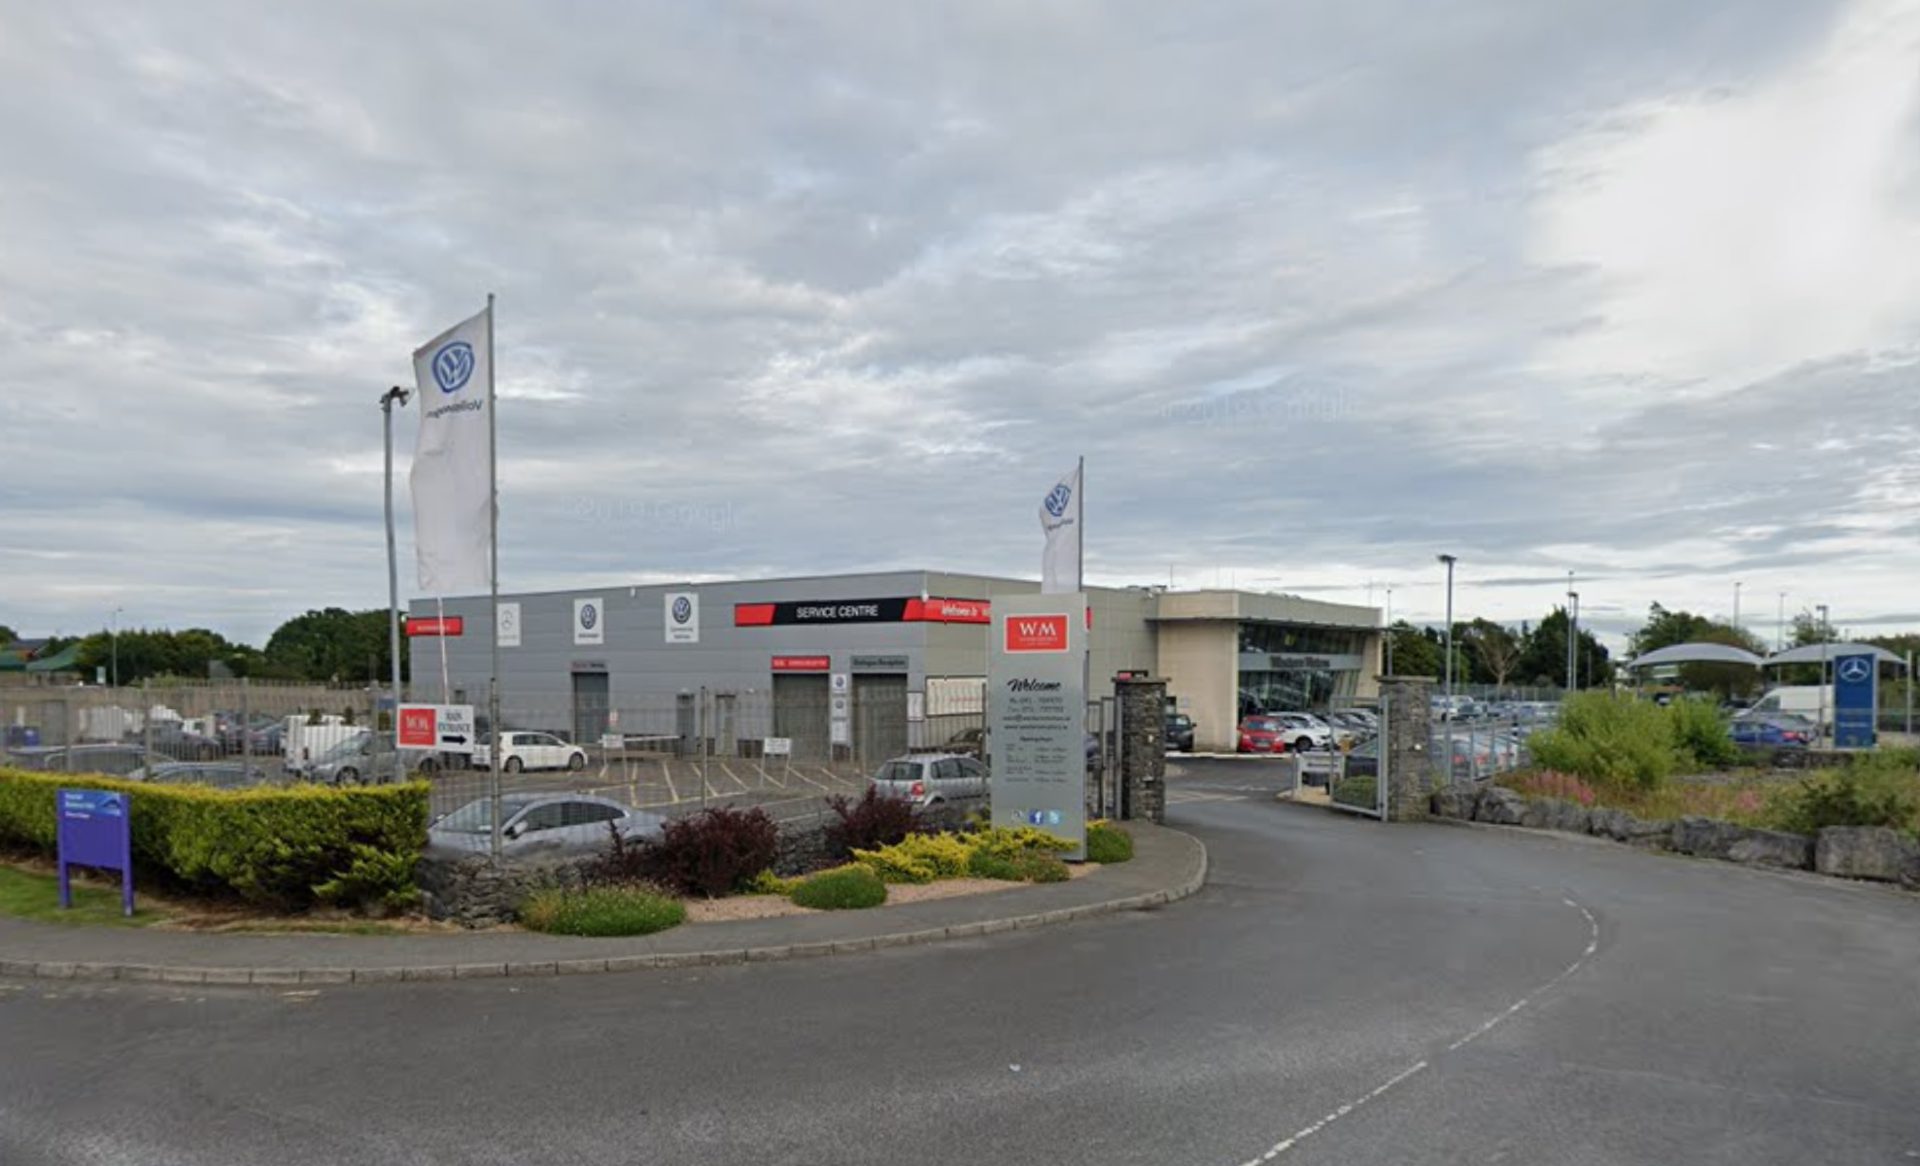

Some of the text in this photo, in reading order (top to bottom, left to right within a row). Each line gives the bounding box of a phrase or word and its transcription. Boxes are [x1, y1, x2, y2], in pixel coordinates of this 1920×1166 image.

[796, 605, 879, 618] SERVICE CENTRE
[1007, 679, 1060, 692] Welcome
